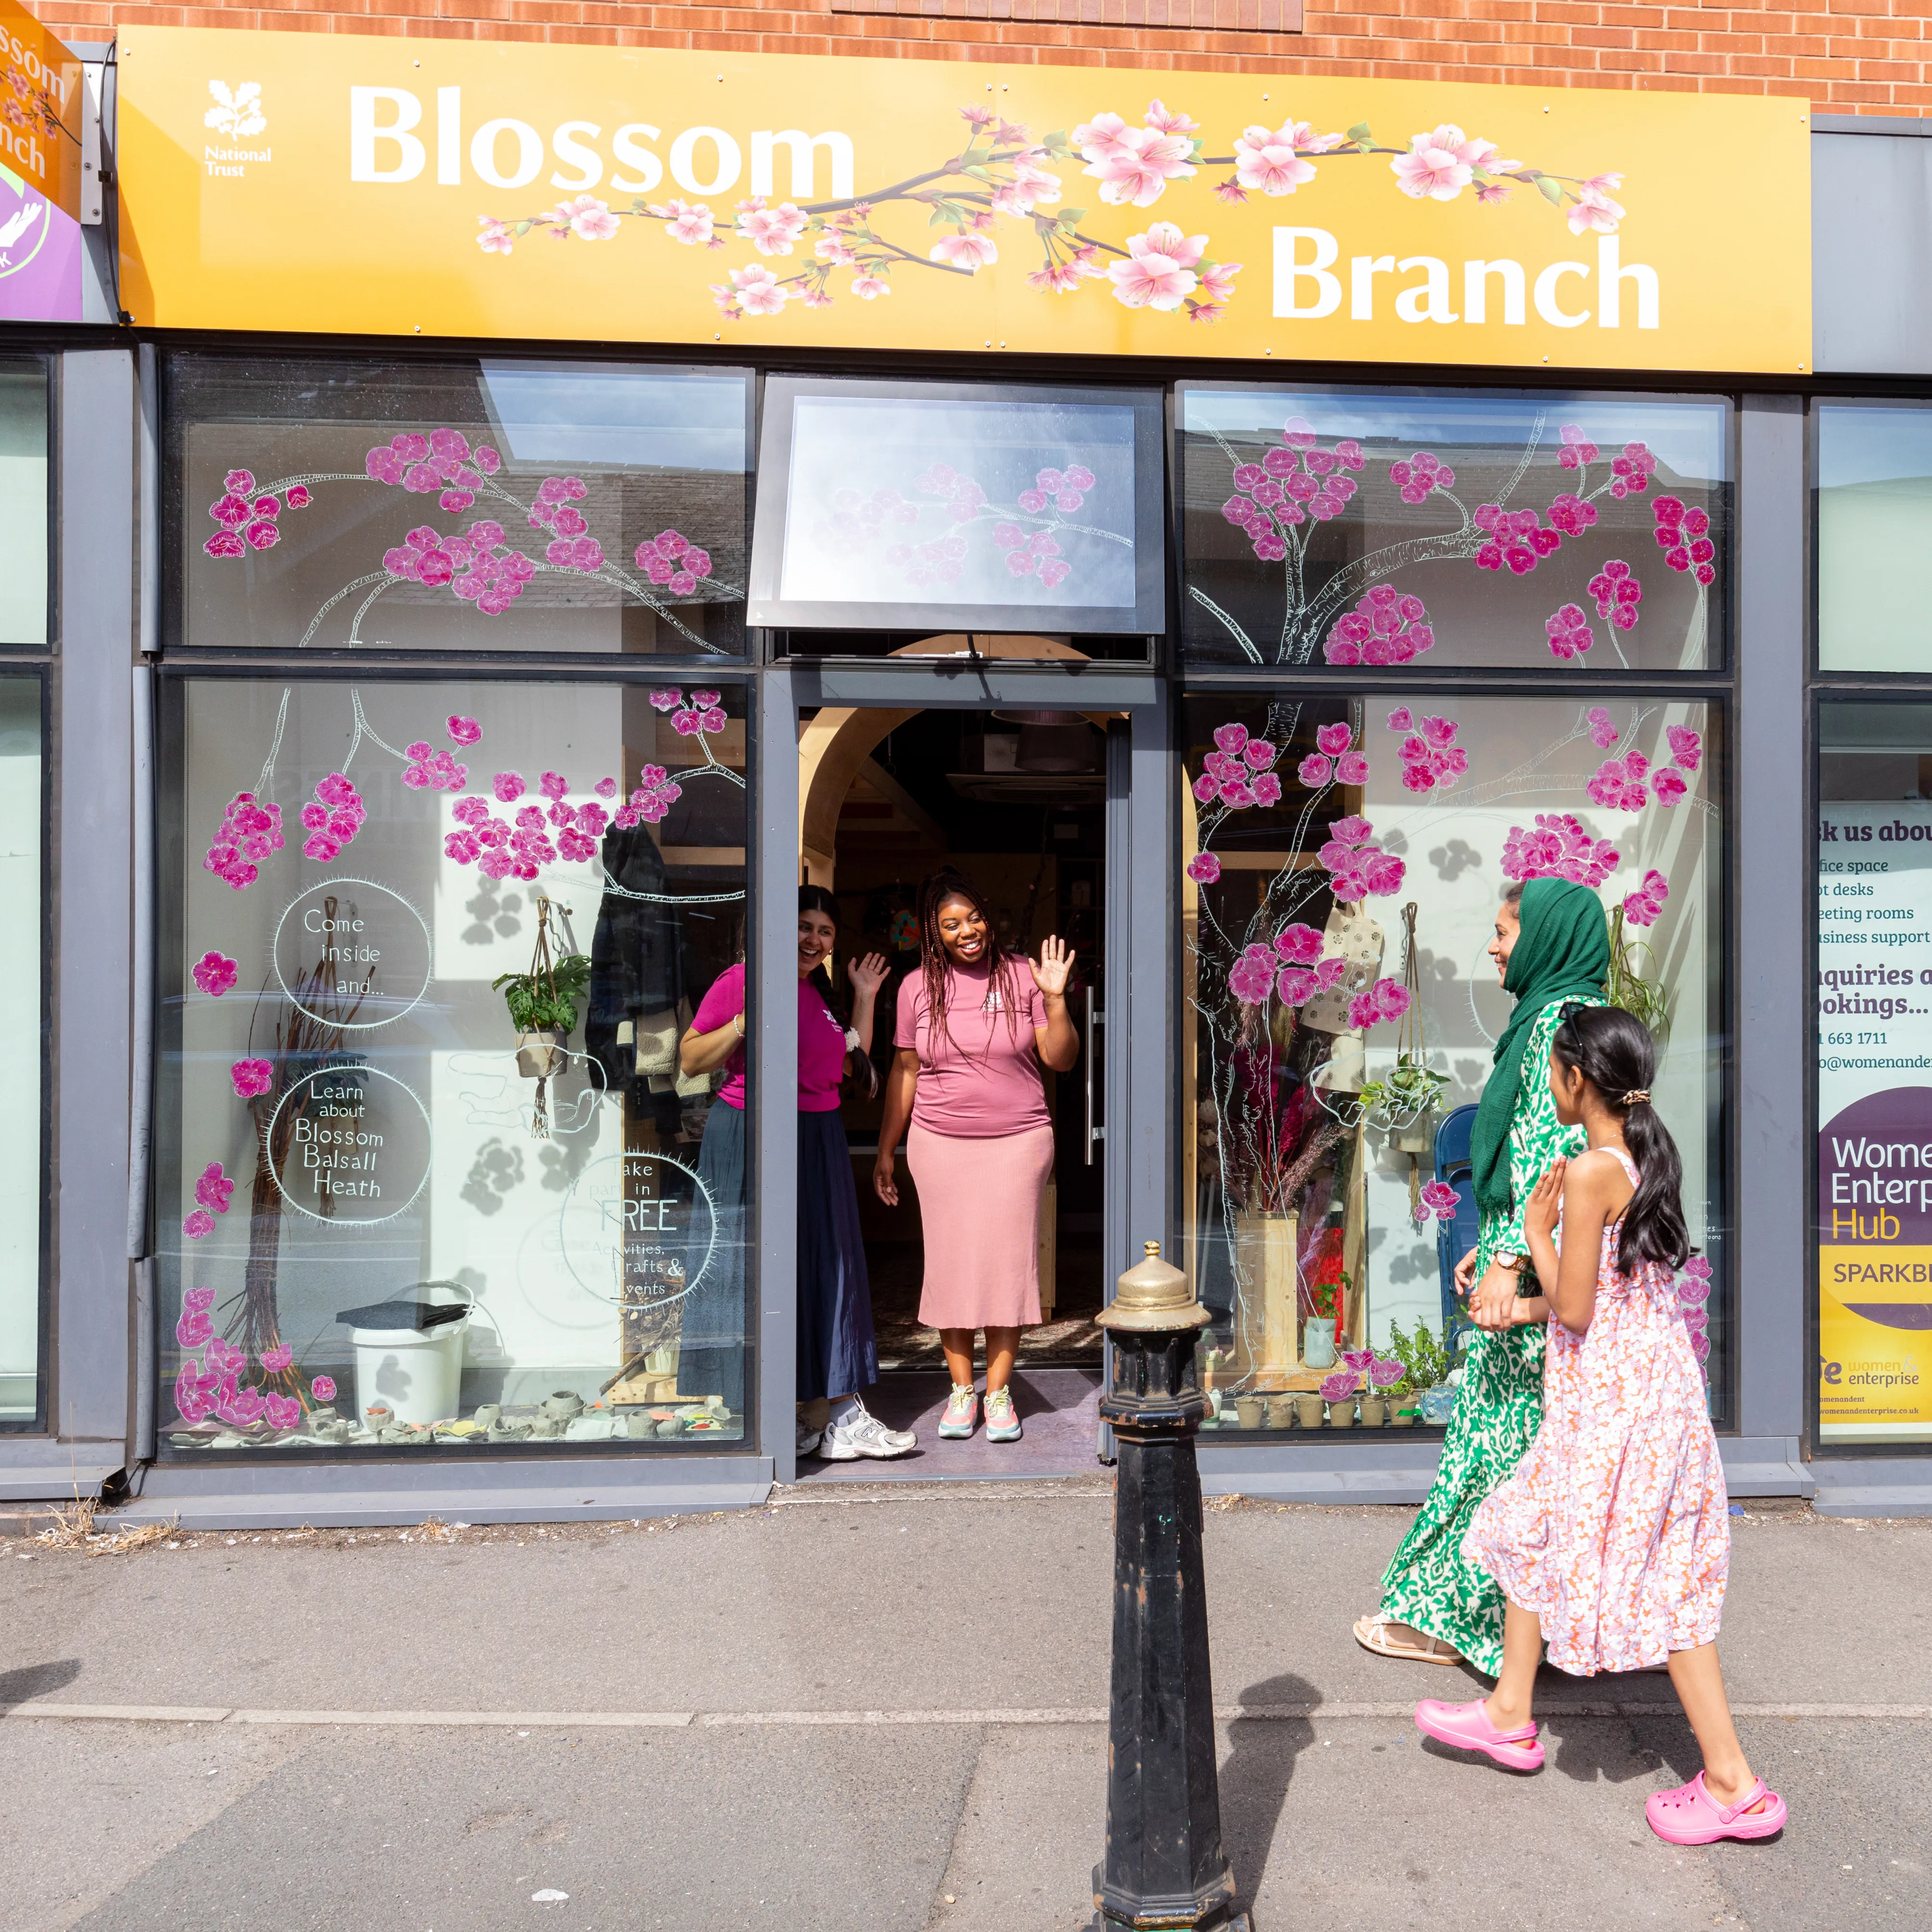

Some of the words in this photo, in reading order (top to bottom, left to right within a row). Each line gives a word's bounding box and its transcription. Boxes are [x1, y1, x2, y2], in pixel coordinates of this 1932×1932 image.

[350, 86, 854, 199] Blossom
[205, 146, 271, 162] National
[205, 162, 245, 177] Trust
[1272, 226, 1659, 329] Branch
[1844, 826, 1872, 841] us
[1847, 861, 1888, 875] space
[1833, 883, 1874, 896] desks
[304, 908, 365, 934] Come
[1866, 908, 1914, 920] rooms
[1871, 931, 1931, 946] support
[321, 944, 381, 963] inside
[336, 977, 384, 996] and...
[1819, 992, 1929, 1020] okings...
[1828, 1032, 1853, 1044] 663
[1857, 1032, 1887, 1044] 1711
[310, 1080, 364, 1100] Learn
[319, 1104, 365, 1118] about
[295, 1118, 383, 1147] Blossom
[304, 1144, 377, 1171] Balsall
[1832, 1137, 1932, 1168] Wome
[608, 1161, 653, 1176] Take
[313, 1170, 381, 1198] Heath
[636, 1183, 650, 1195] in
[1832, 1172, 1932, 1212] Enterp
[601, 1199, 678, 1232] FREE
[1832, 1208, 1900, 1240] Hub
[611, 1257, 663, 1274] Crafts
[667, 1258, 684, 1276] &
[1833, 1263, 1932, 1283] SPARKB
[614, 1277, 665, 1295] Events
[1848, 1361, 1901, 1372] women
[1903, 1356, 1918, 1373] &
[1849, 1372, 1919, 1388] enterprise
